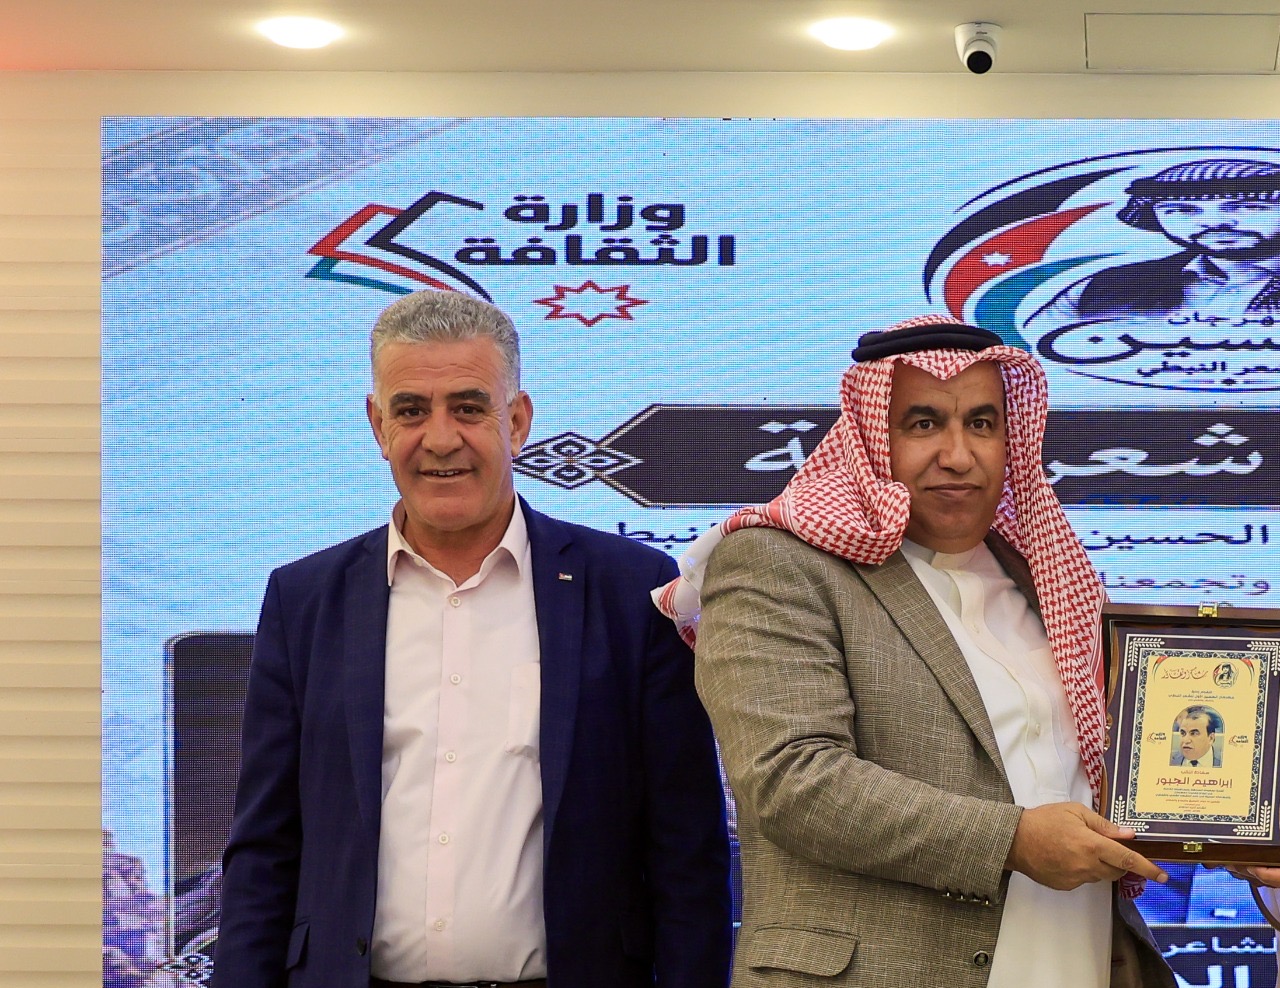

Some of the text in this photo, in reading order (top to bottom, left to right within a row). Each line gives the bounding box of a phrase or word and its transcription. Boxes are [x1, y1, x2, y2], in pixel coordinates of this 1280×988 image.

[502, 192, 686, 233] وزارة
[453, 232, 737, 267] الثقافة
[1082, 524, 1270, 551] الحسين
[1155, 776, 1233, 789] إبراهيم الجبور
[1163, 936, 1277, 958] لشاعر
